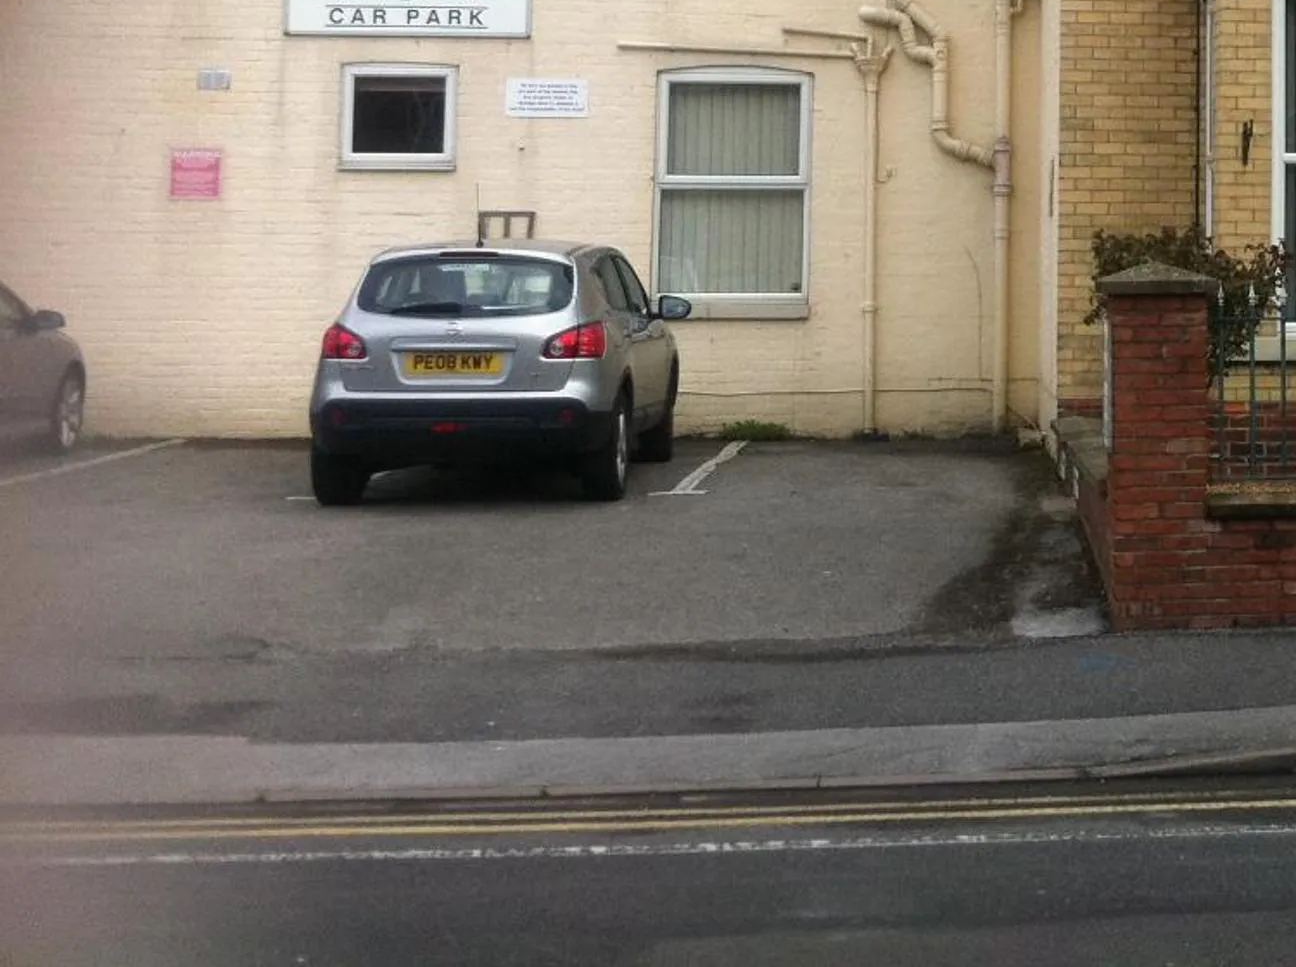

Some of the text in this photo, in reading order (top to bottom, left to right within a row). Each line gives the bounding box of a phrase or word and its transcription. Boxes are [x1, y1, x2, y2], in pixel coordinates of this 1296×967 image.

[329, 8, 485, 25] CAR PARK
[460, 354, 493, 370] KWY
